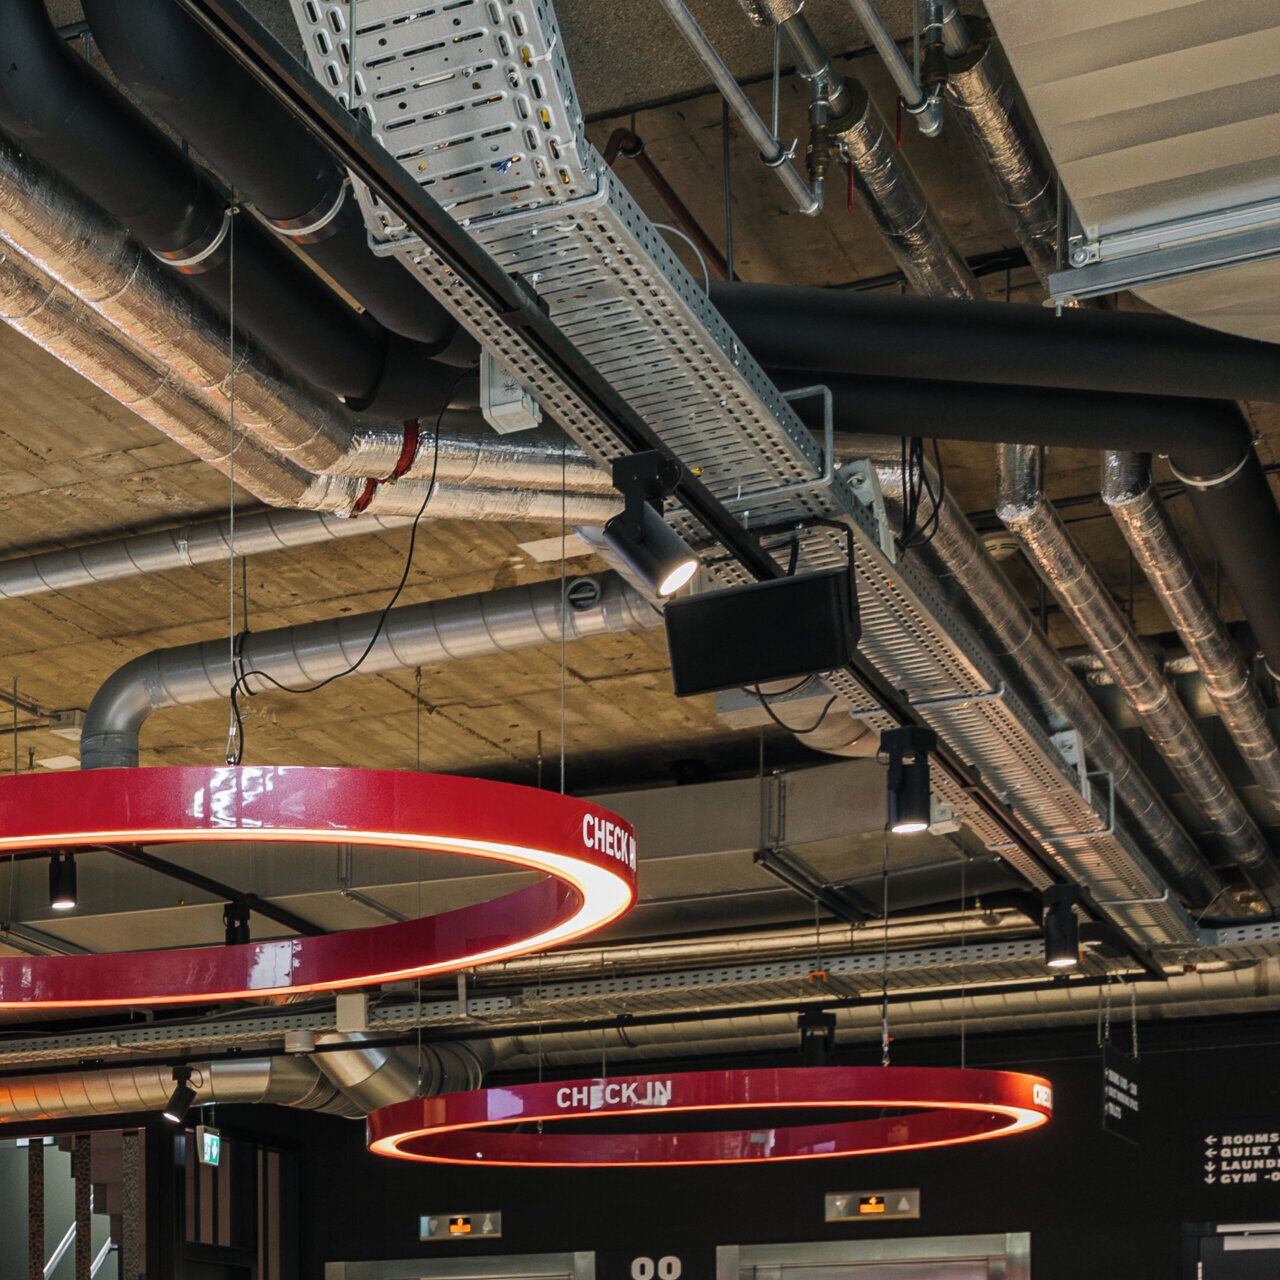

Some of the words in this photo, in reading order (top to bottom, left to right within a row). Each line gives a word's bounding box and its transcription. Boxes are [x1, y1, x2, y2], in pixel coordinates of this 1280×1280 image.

[583, 813, 628, 865] CHECK
[556, 1082, 639, 1108] CHECK
[646, 1080, 672, 1104] IN
[1221, 1132, 1280, 1145] ROOMS
[1220, 1146, 1272, 1158] QUIET
[1221, 1159, 1280, 1171] LAUND
[1220, 1172, 1257, 1184] GYM
